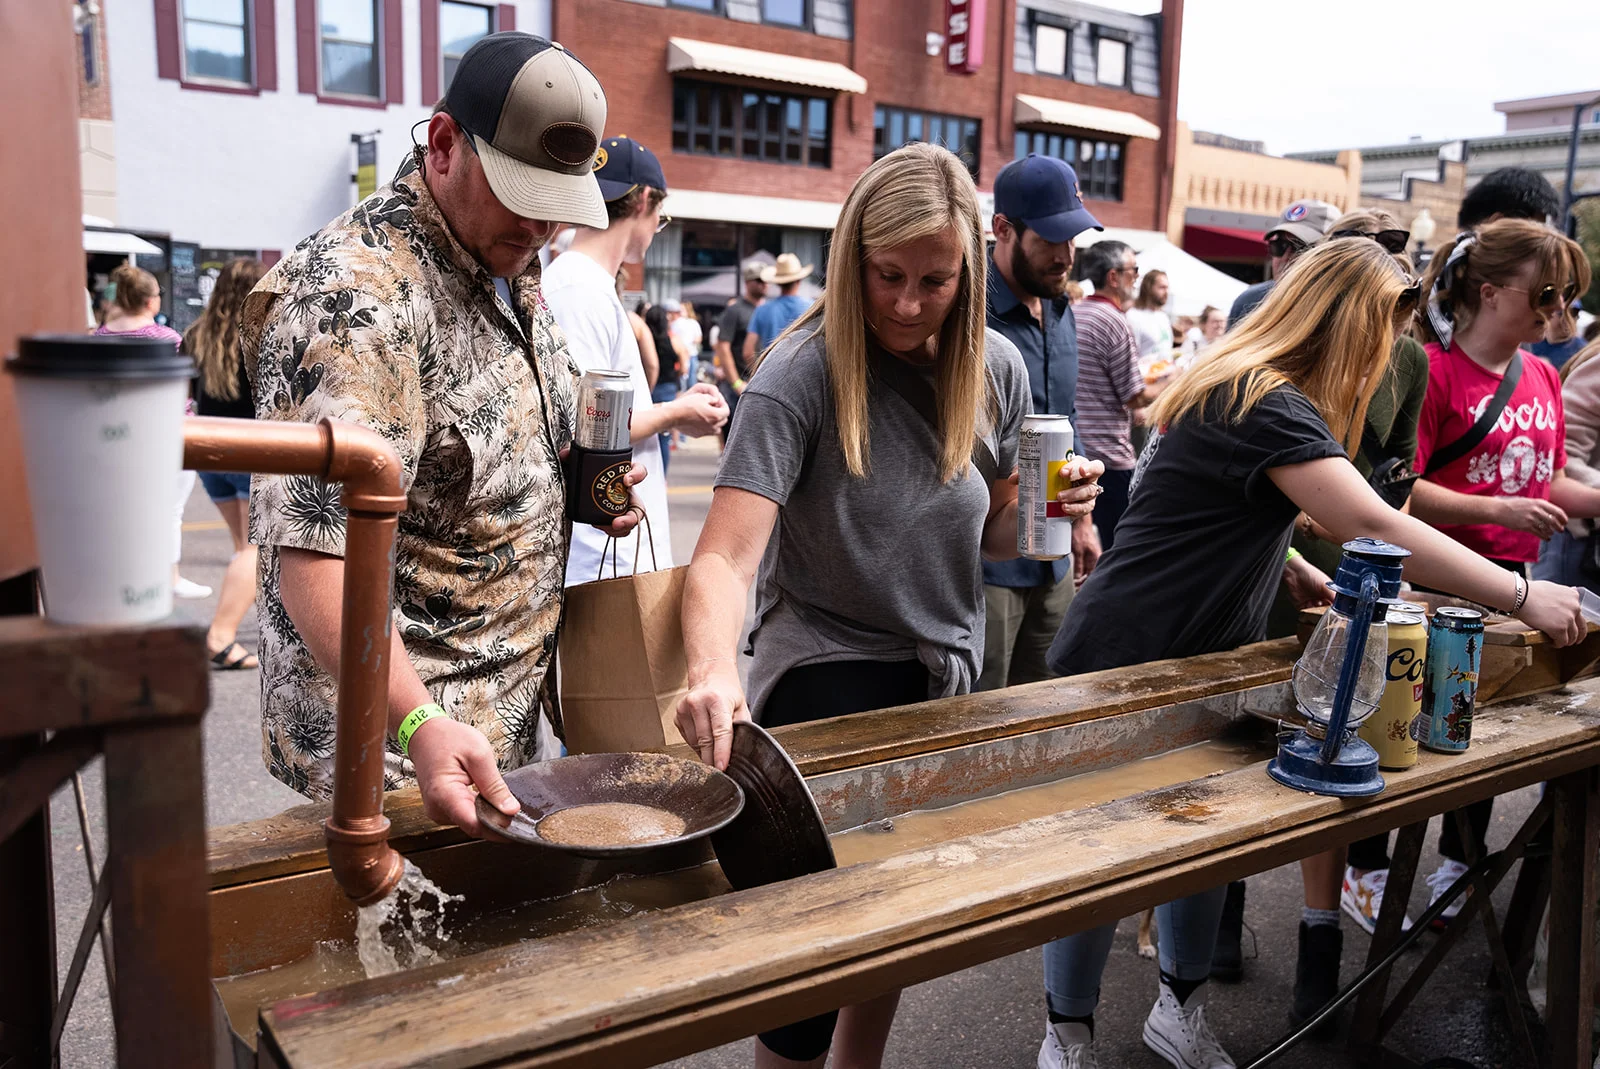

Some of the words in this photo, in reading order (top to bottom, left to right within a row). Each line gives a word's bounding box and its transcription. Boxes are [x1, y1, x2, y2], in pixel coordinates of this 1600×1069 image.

[948, 0, 968, 65] SE
[586, 405, 611, 418] Coors
[588, 415, 608, 423] LIGHT
[596, 470, 616, 490] RED
[618, 464, 632, 473] RO
[1386, 647, 1424, 682] Co
[409, 709, 429, 726] 21+
